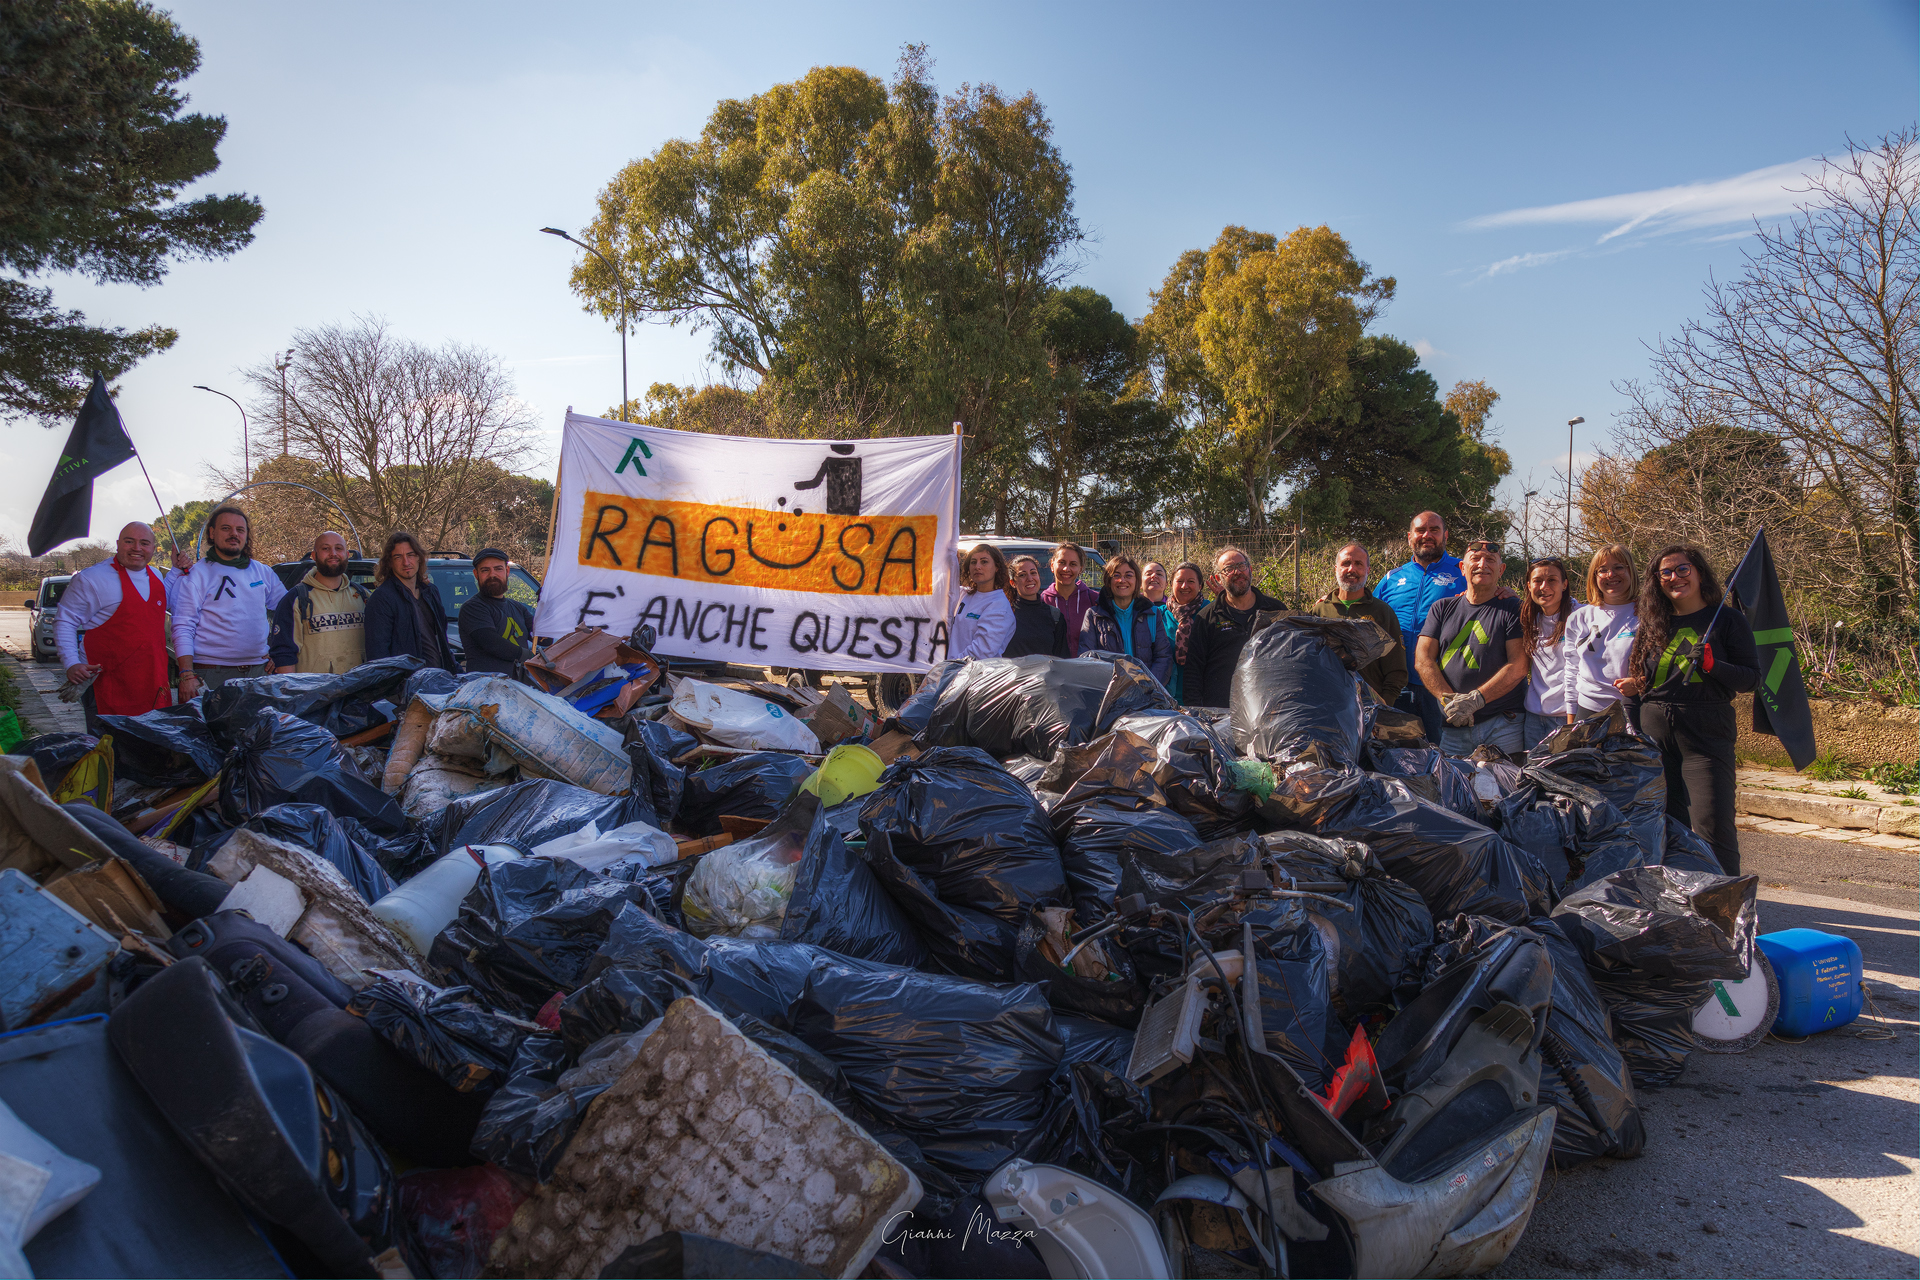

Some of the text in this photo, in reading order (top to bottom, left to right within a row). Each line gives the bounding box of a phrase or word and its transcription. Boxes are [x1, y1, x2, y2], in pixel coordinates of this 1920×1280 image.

[586, 505, 918, 594] RAGUSA
[632, 596, 774, 650] ANCHE
[789, 611, 949, 663] QUESTA
